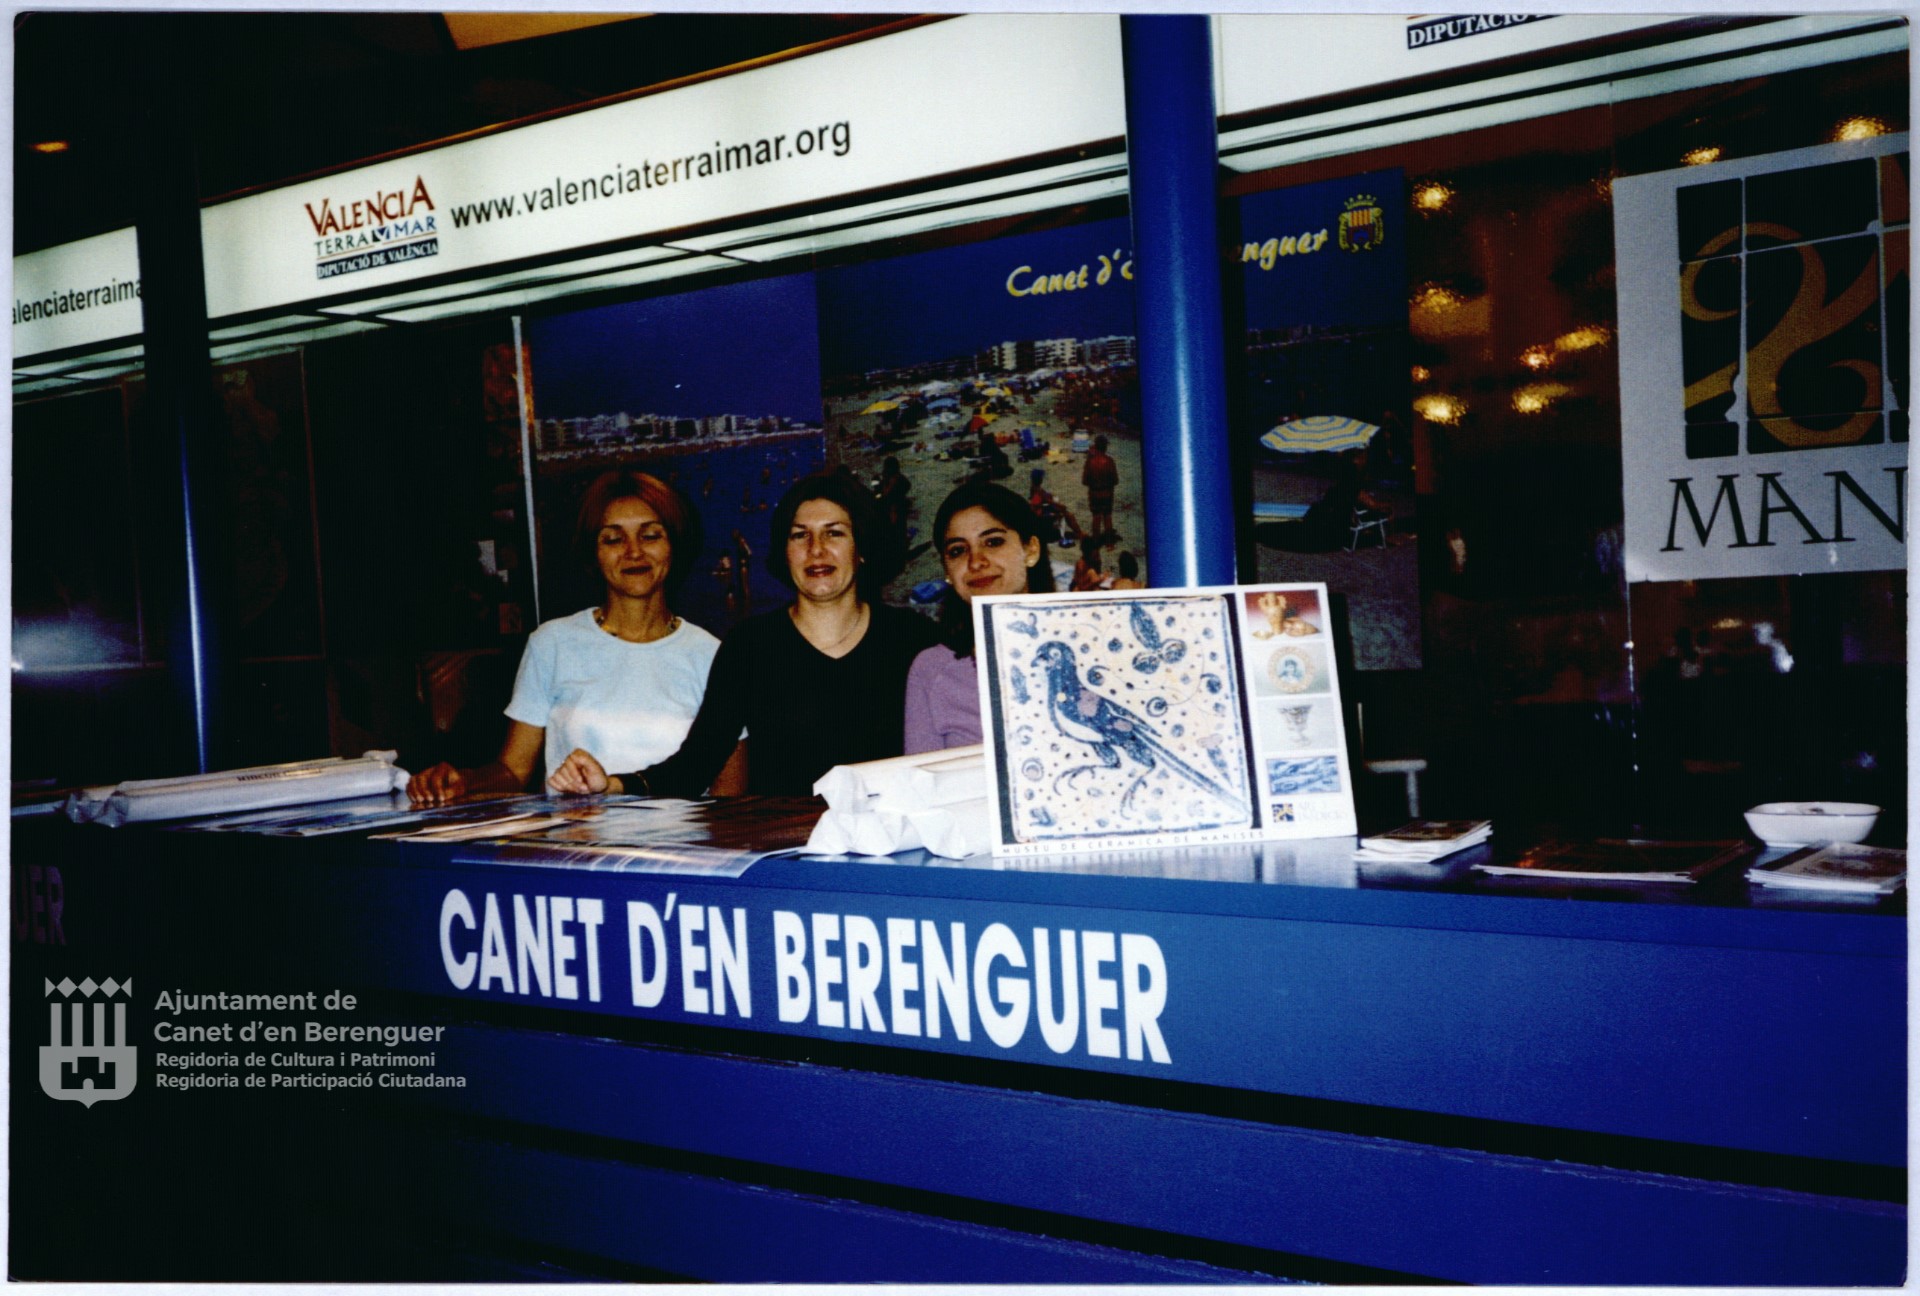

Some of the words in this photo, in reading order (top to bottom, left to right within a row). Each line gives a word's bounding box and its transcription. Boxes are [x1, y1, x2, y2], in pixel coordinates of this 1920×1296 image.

[450, 120, 850, 229] www.valenciaterraimar.org
[304, 174, 435, 237] VALENCIA
[314, 233, 369, 256] TERRA
[394, 215, 438, 238] MAR
[372, 252, 387, 265] DE
[1006, 255, 1088, 297] Canet
[1002, 844, 1050, 855] MUSEU
[1061, 841, 1078, 852] DE
[1174, 832, 1190, 844] DE
[1201, 829, 1265, 843] MANISES
[440, 888, 604, 1003] CANET
[627, 892, 752, 1018] D'EN
[773, 910, 1173, 1065] BERENGUER
